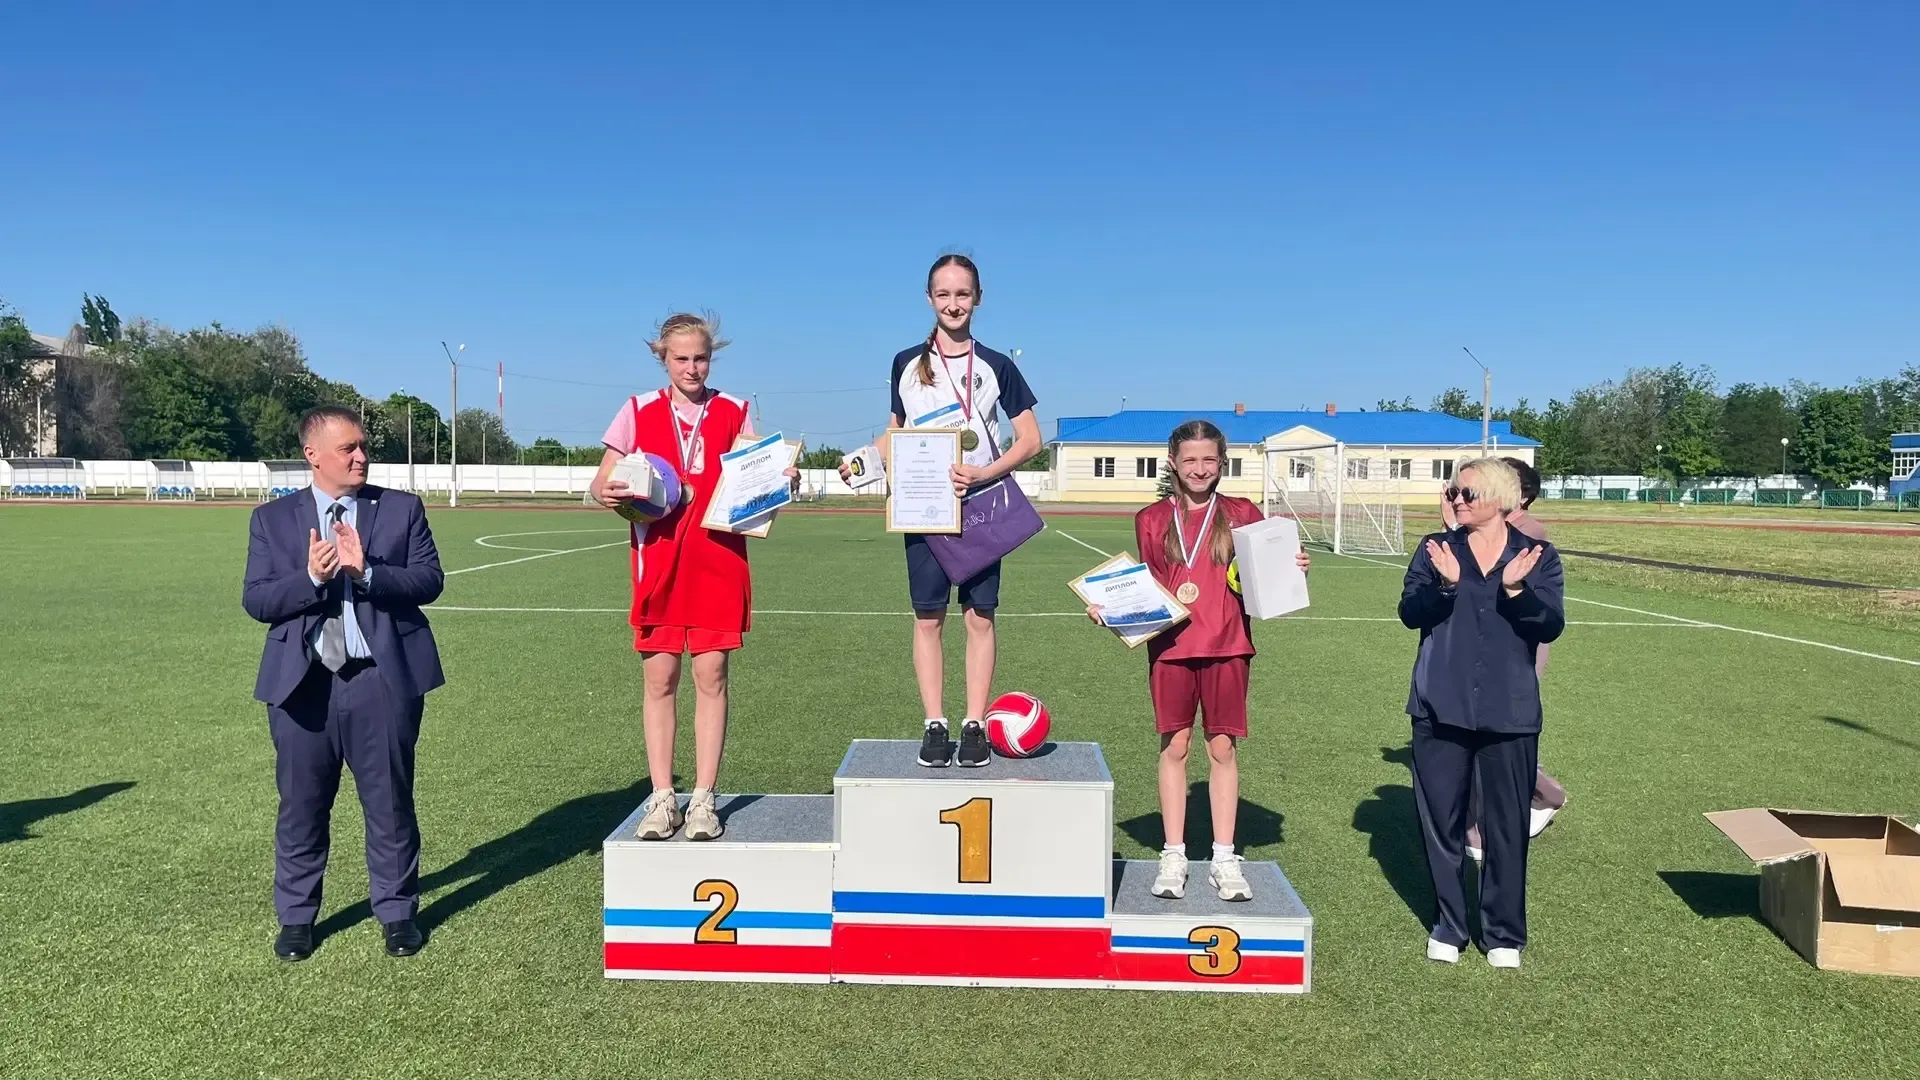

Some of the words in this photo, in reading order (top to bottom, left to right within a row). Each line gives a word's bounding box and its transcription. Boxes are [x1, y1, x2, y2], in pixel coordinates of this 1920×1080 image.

[740, 454, 772, 471] ДИПЛОМ
[1105, 580, 1137, 593] ДИПЛОМ
[939, 797, 993, 883] 1
[693, 879, 739, 944] 2
[1188, 926, 1241, 976] 3
